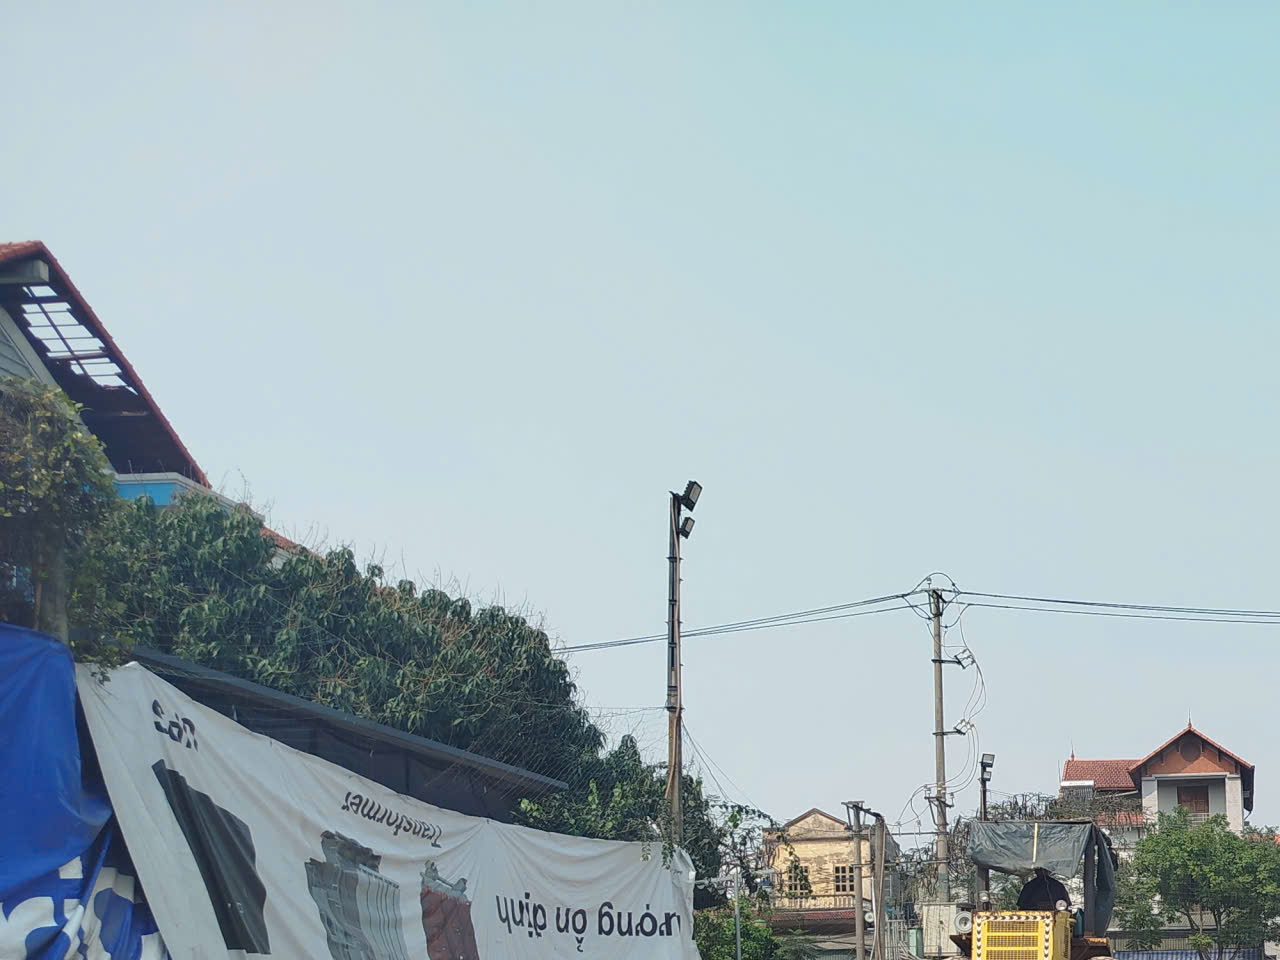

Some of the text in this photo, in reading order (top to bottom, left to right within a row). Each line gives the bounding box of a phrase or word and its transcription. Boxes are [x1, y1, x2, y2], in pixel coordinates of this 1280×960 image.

[341, 791, 442, 849] Transformer
[495, 891, 547, 938] định
[555, 906, 588, 953] ổn
